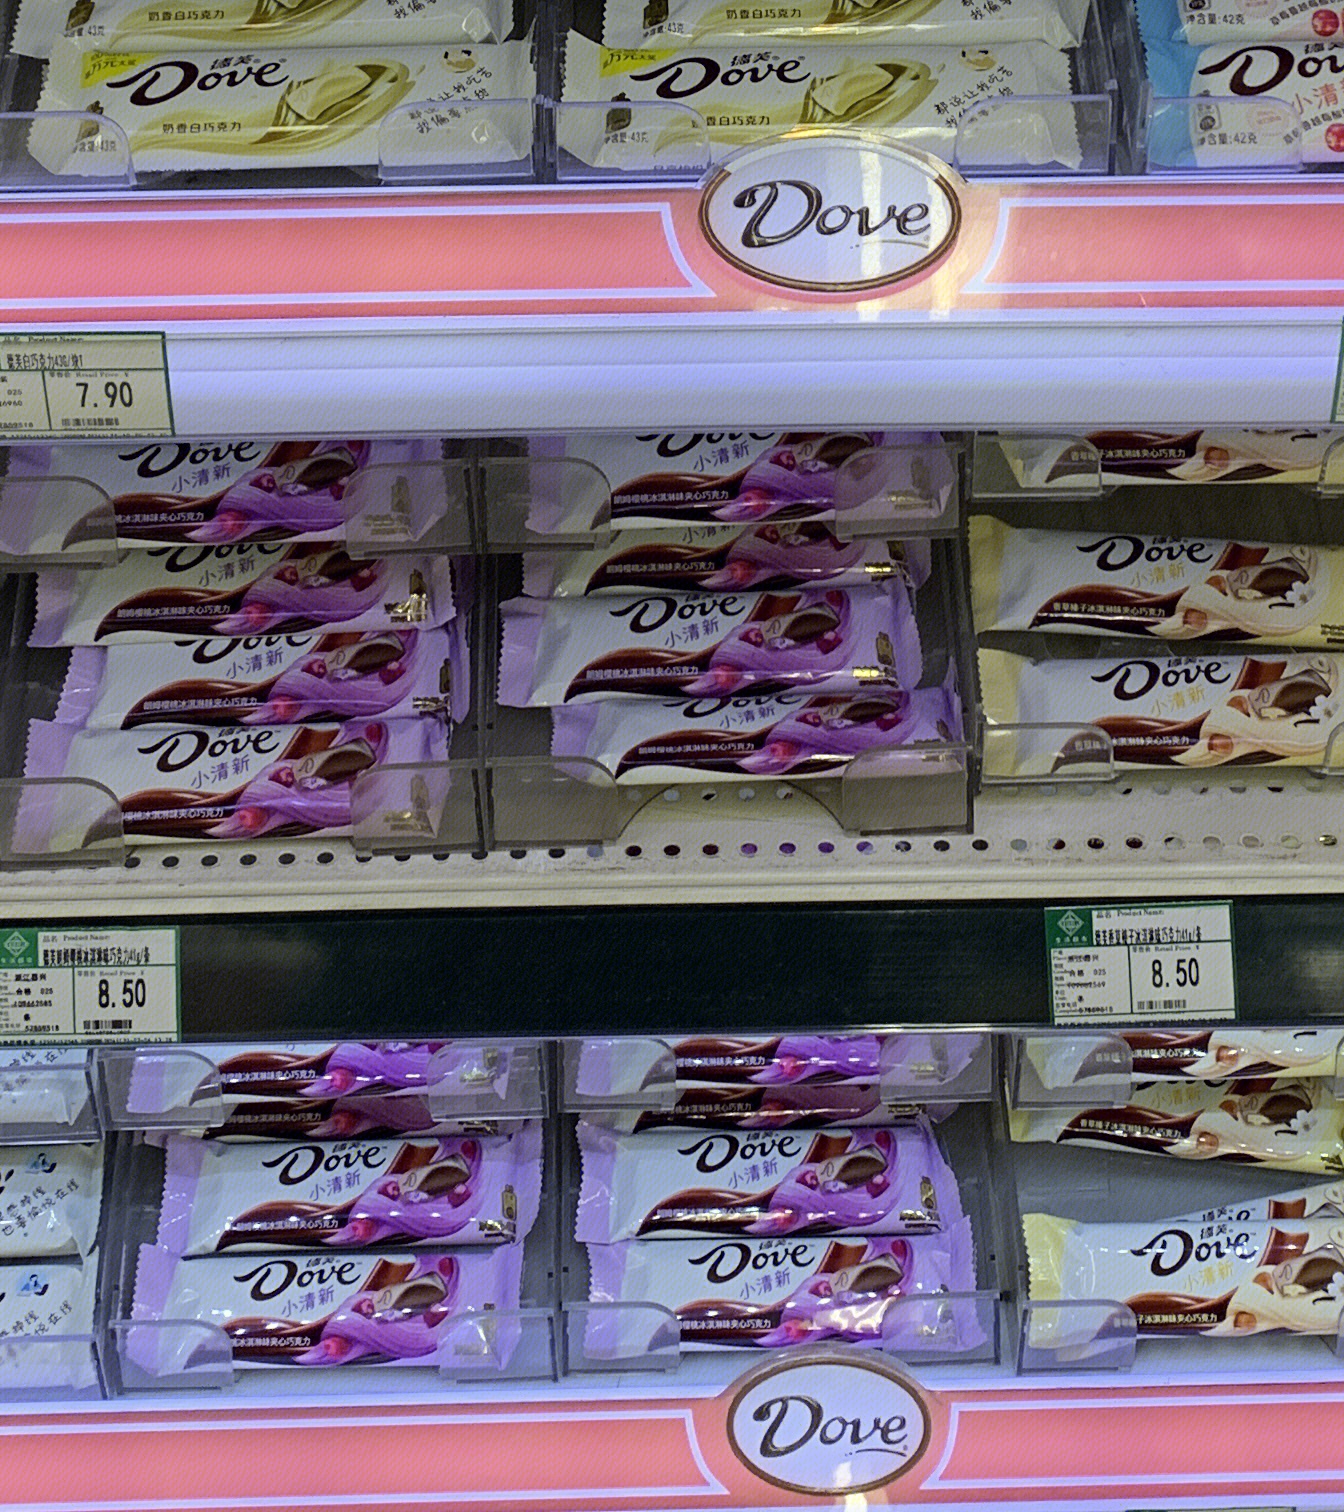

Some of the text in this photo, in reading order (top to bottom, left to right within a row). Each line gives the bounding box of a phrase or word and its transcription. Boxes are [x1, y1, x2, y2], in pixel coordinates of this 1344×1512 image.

[107, 60, 290, 107] Dove
[629, 58, 811, 99] Dove
[733, 179, 930, 248] Dove
[76, 382, 133, 408] 7.90
[692, 441, 750, 472] 小清新
[171, 463, 233, 494] 小清新
[1076, 536, 1214, 572] Dove
[198, 557, 256, 587] 小清新
[610, 596, 746, 634] Dove
[664, 617, 720, 648] 小清新
[225, 647, 284, 680] 小清新
[1091, 660, 1232, 700] Dove
[137, 730, 280, 773] Dove
[191, 756, 251, 789] 小清新
[1152, 957, 1199, 988] 8.50
[98, 978, 146, 1008] 8.50
[262, 1145, 388, 1186] Dove
[677, 1134, 801, 1173] Dove
[309, 1171, 362, 1201] 小清新
[727, 1158, 779, 1189] 小清新
[688, 1242, 815, 1283] Dove
[233, 1259, 361, 1301] Dove
[739, 1268, 791, 1300] 小清新
[282, 1288, 336, 1317] 小清新
[752, 1396, 907, 1458] Dove
